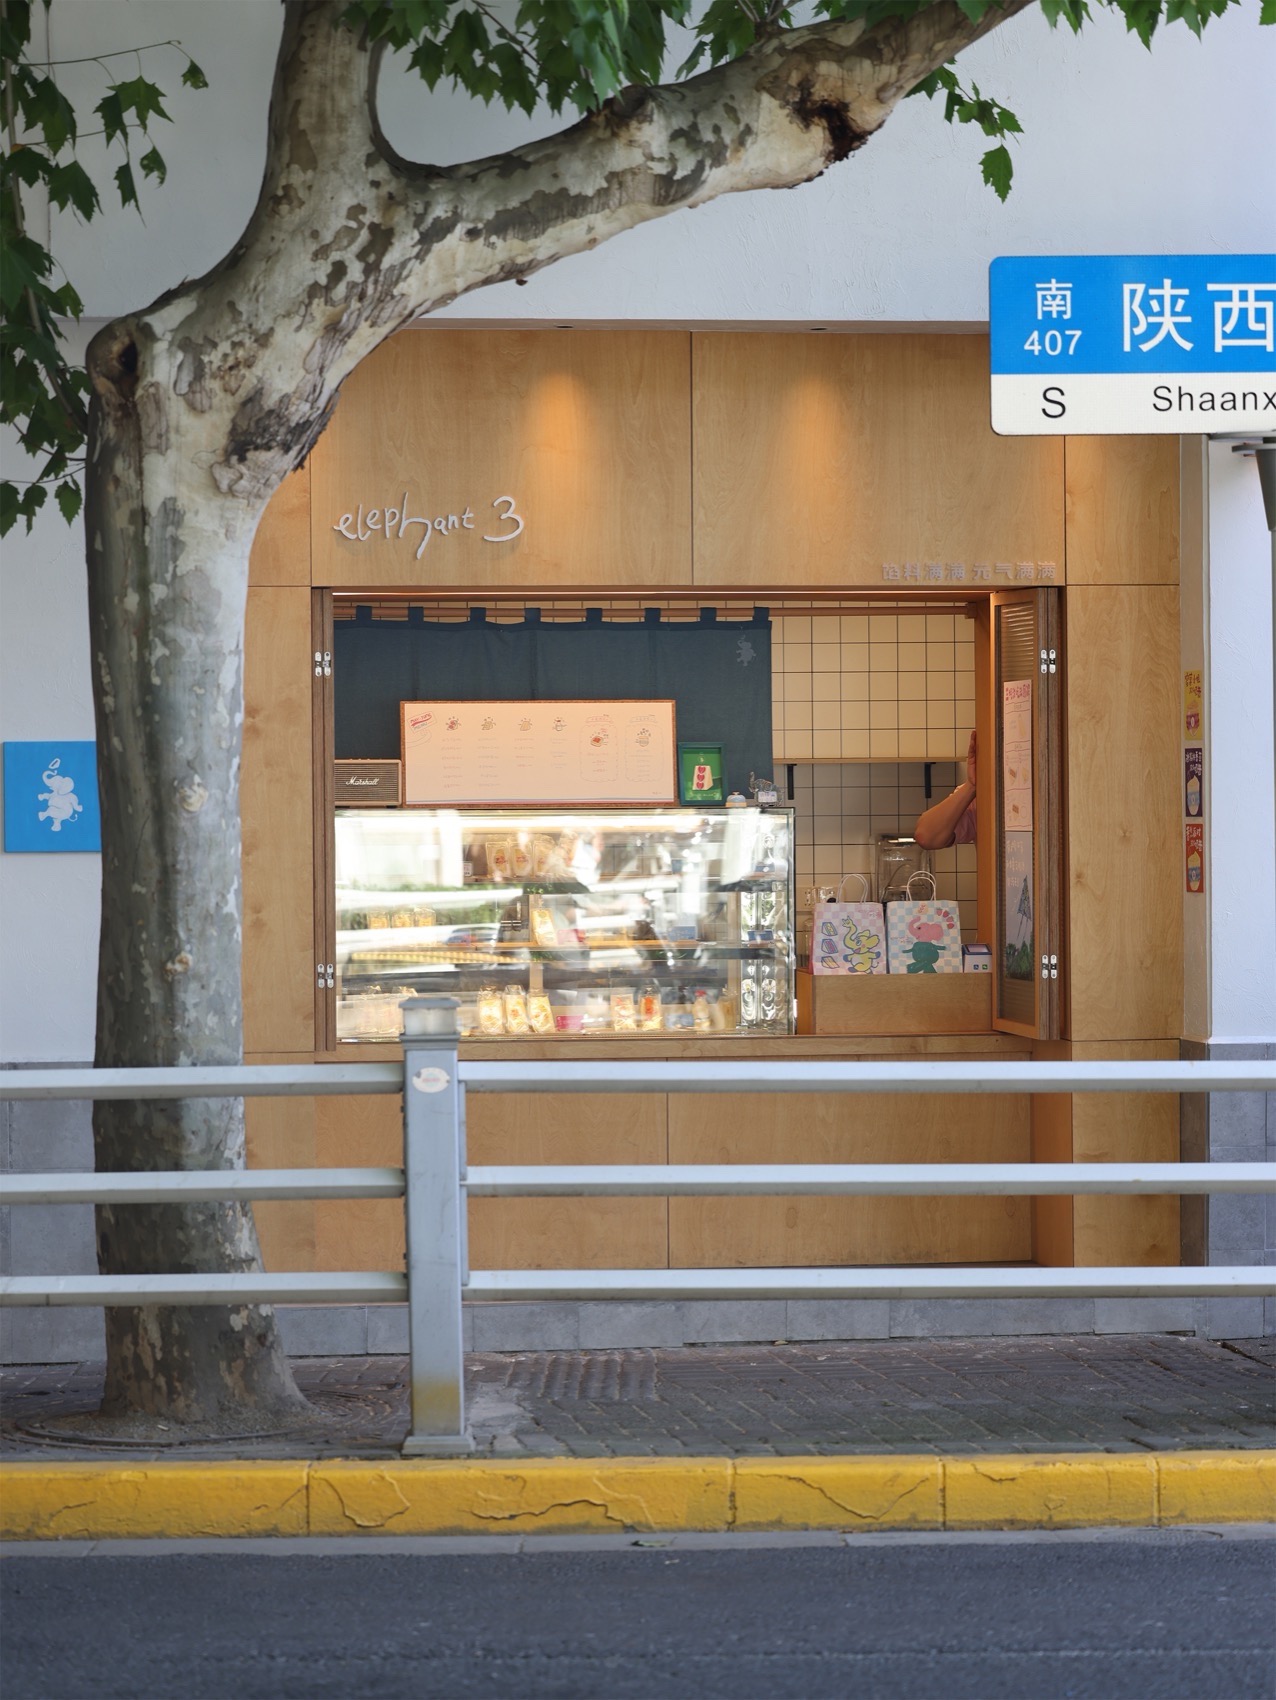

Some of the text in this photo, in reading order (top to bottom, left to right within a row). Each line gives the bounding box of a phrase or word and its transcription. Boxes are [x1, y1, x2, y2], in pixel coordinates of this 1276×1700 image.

[1035, 278, 1073, 320] 南
[1122, 278, 1276, 353] 陕西
[1023, 330, 1083, 356] 407
[1041, 386, 1067, 419] S
[333, 491, 525, 560] elephant 3
[972, 561, 1057, 580] 元气满满
[345, 775, 380, 786] Marshall
